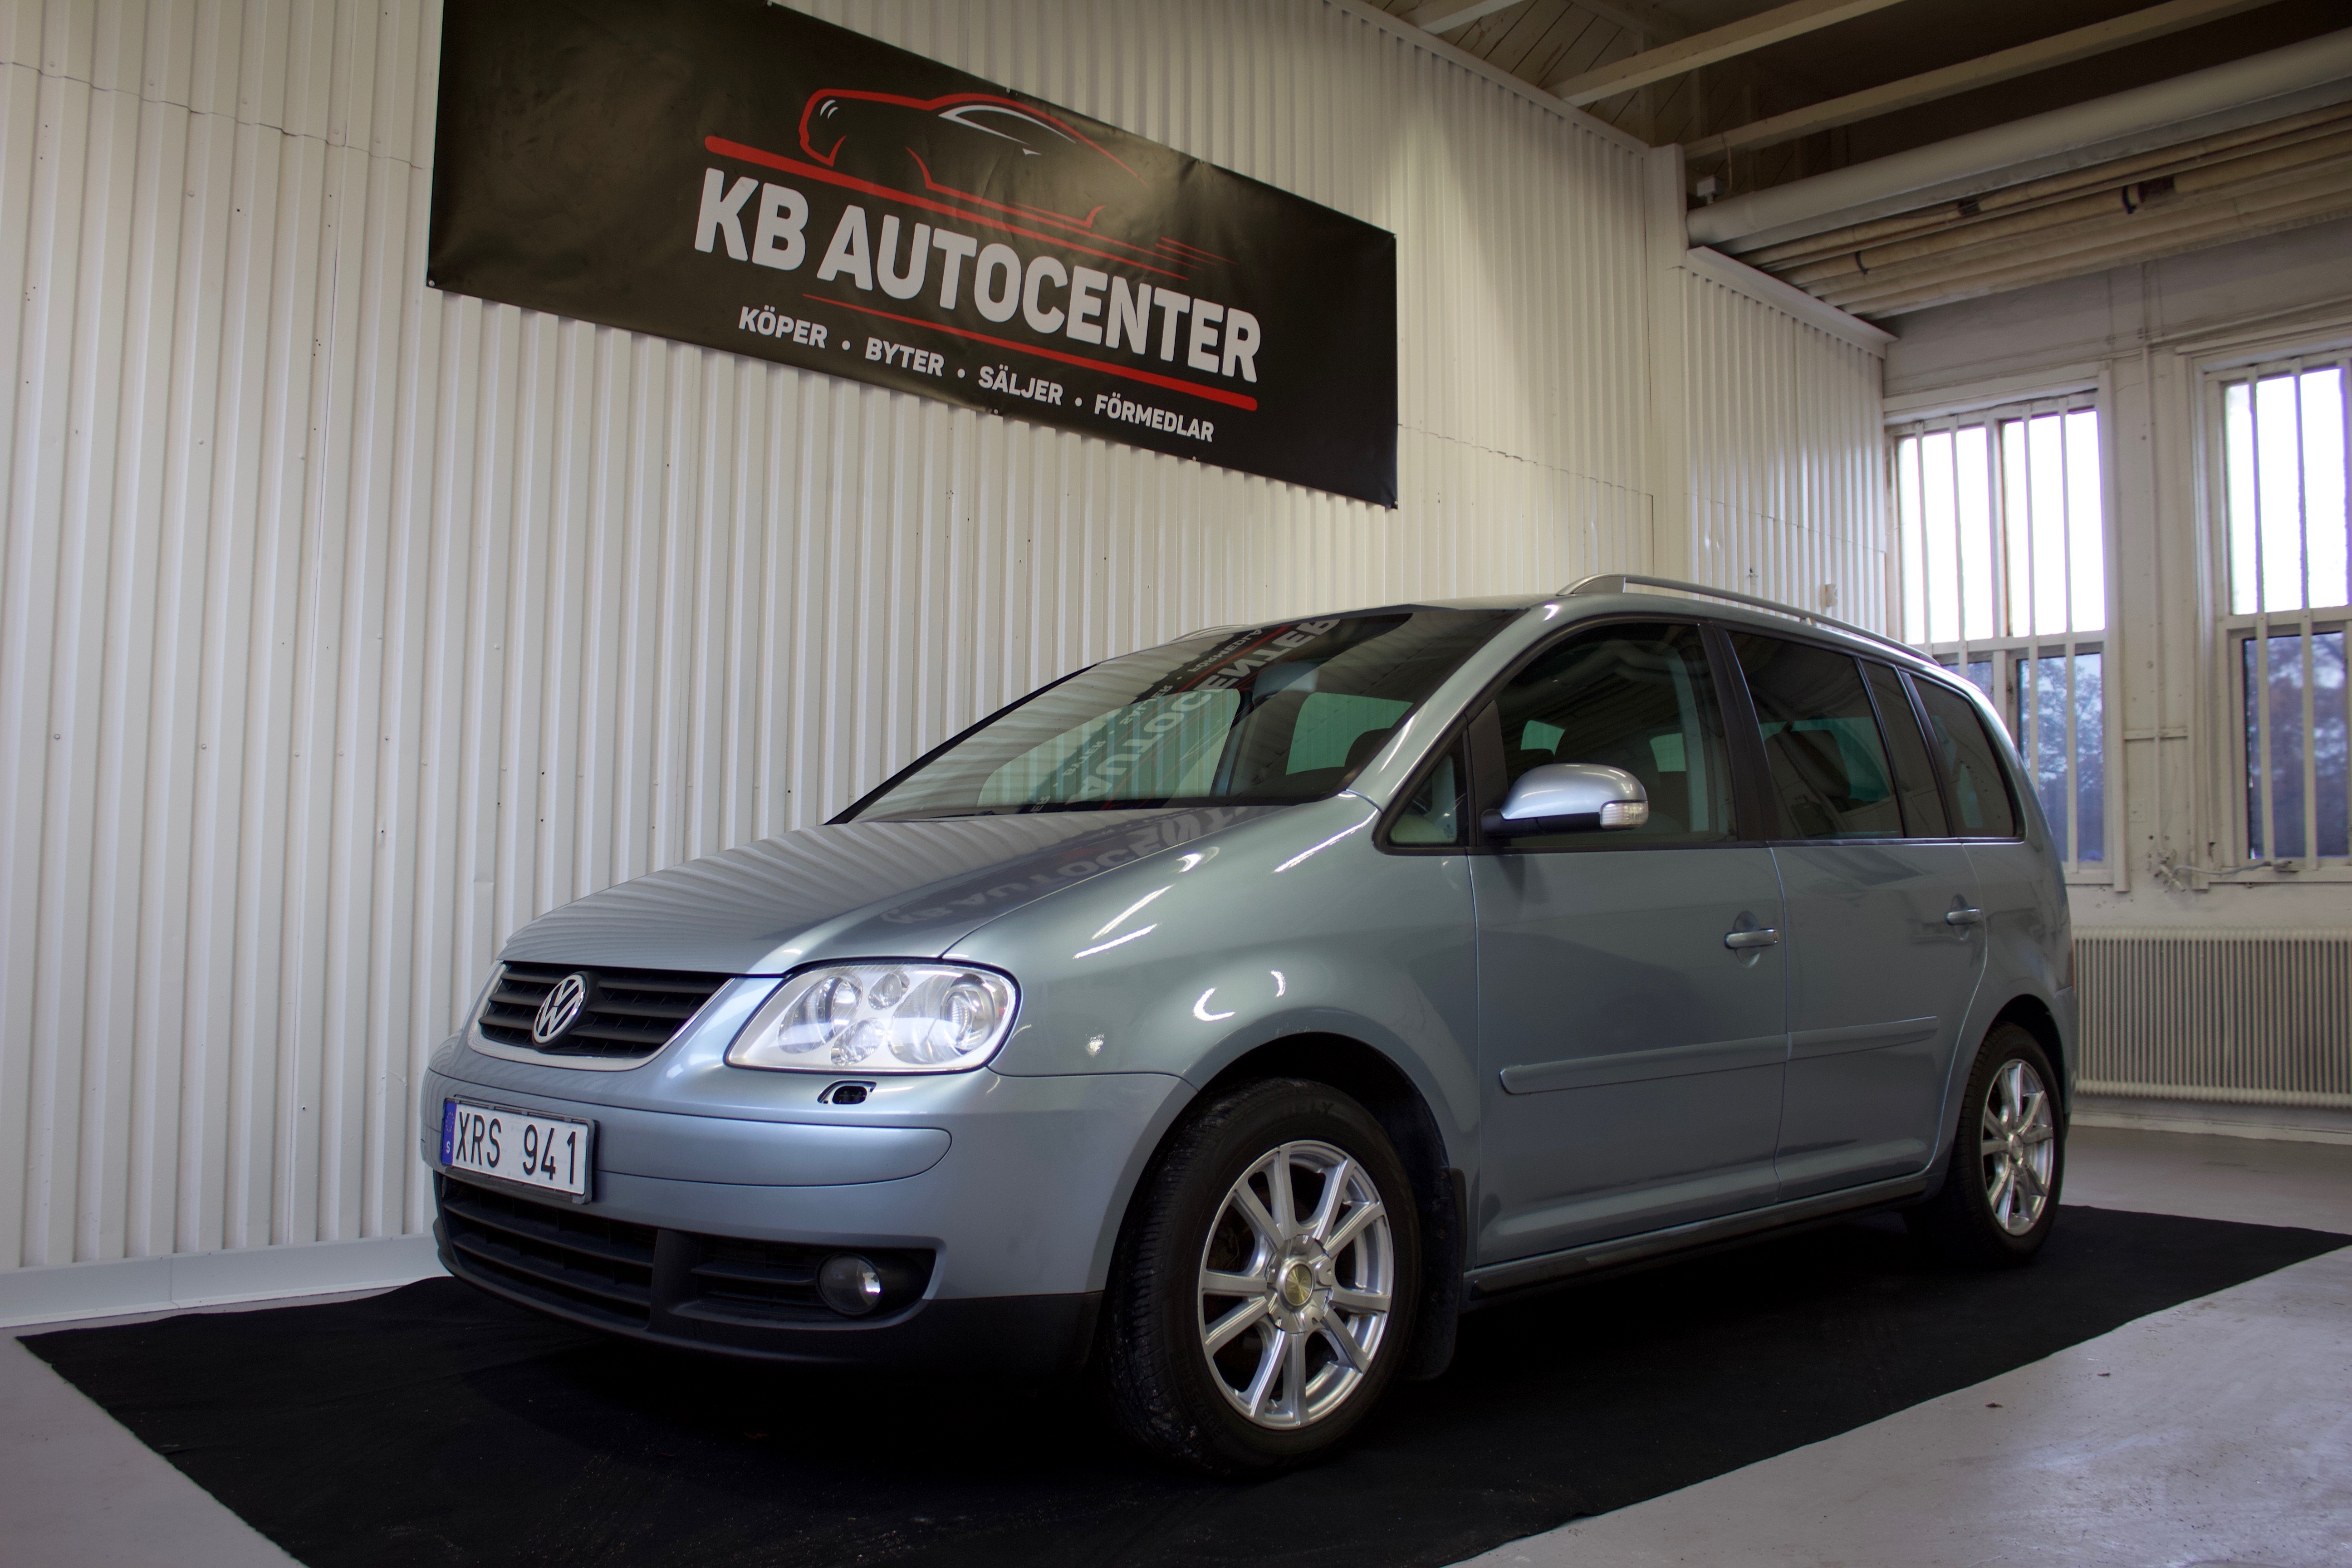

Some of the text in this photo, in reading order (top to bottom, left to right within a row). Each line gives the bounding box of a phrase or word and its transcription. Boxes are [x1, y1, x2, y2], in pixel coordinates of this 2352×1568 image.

[695, 168, 1261, 382] KB AUTOCENTER
[739, 305, 1214, 442] KÖPER BYTER SÄLJER FÖRMEDLAR
[446, 1140, 451, 1154] S
[456, 1112, 576, 1185] XRS 941
